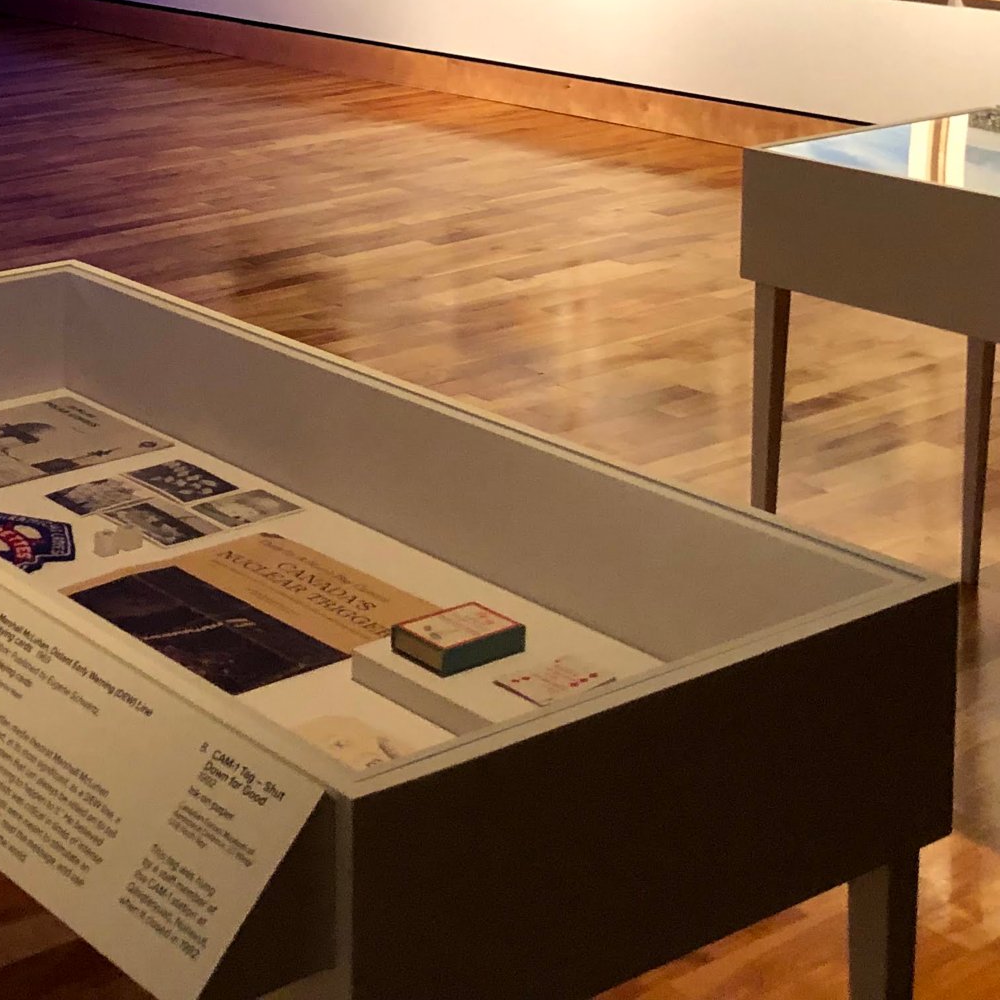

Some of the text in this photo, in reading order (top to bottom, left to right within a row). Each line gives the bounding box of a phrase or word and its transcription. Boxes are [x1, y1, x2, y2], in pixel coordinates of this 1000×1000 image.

[216, 549, 308, 596] NUCLEAR
[277, 560, 378, 612] CANADA'S
[14, 637, 33, 652] cards
[50, 647, 72, 664] Distant
[71, 661, 88, 676] Early
[87, 671, 115, 693] Warning
[135, 701, 153, 716] Line
[204, 760, 267, 806] Down for Good
[211, 749, 239, 771] CAM-1
[238, 766, 256, 784] Tag
[262, 781, 285, 800] Shut
